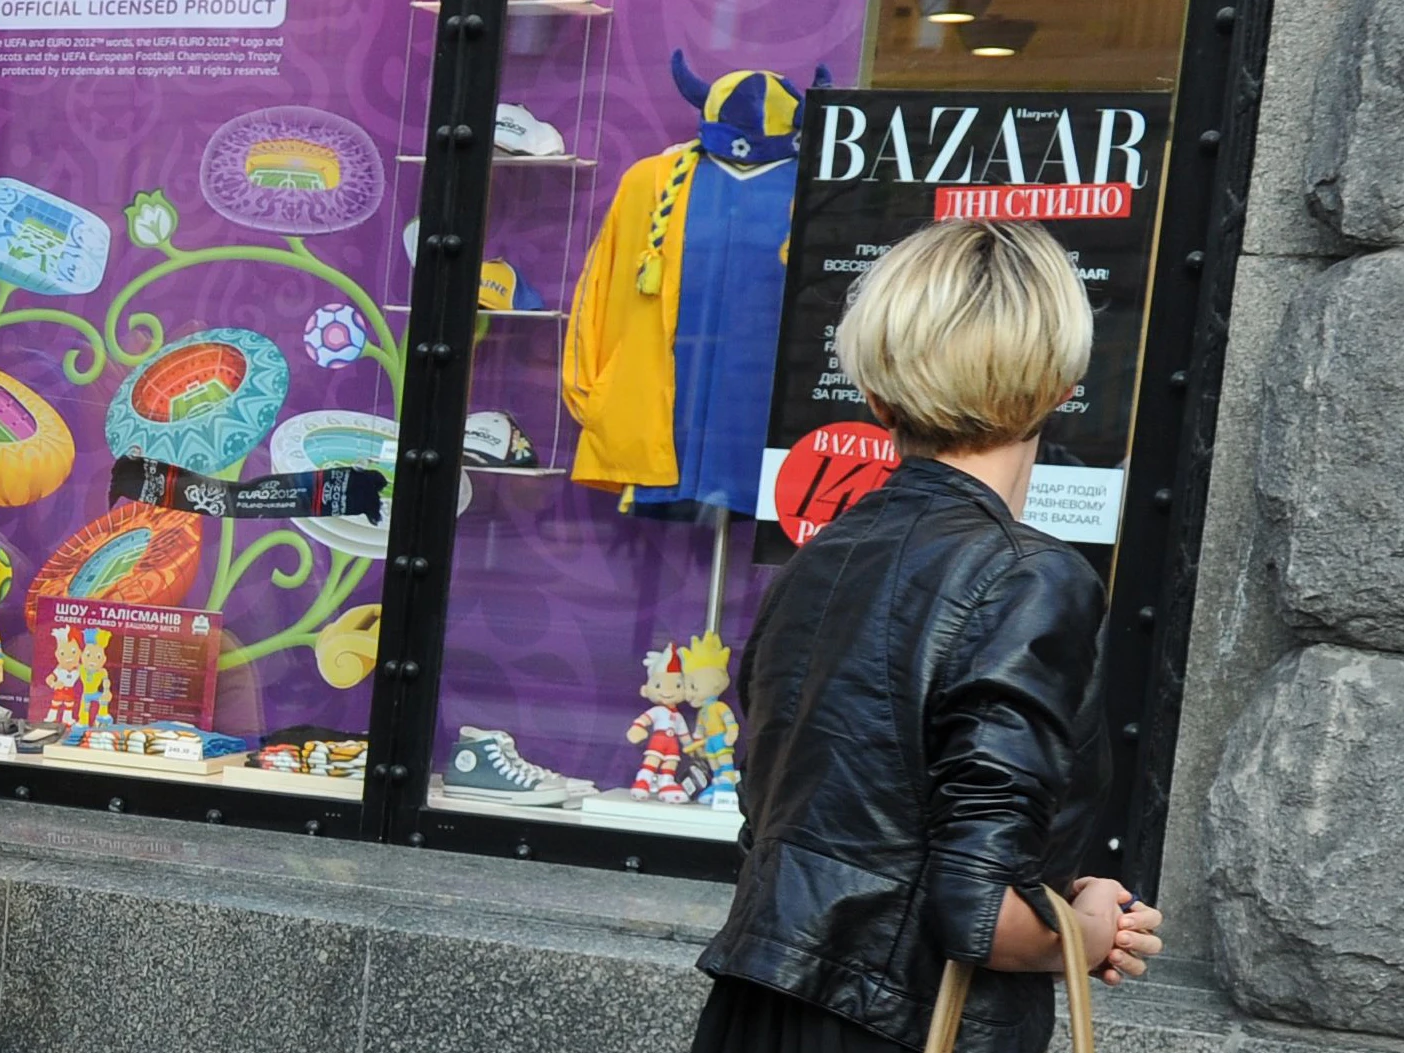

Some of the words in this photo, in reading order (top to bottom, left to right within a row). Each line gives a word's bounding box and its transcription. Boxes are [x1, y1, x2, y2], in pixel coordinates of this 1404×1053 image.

[1, 0, 83, 17] OFFICIAL
[88, 0, 178, 16] LICENSED
[184, 0, 276, 15] PRODUCT
[4, 38, 28, 48] UEFA
[28, 38, 46, 48] and
[46, 38, 72, 48] EURO
[136, 37, 152, 47] the
[153, 37, 177, 47] UEFA
[179, 37, 205, 47] EURO
[241, 38, 264, 49] Logo
[265, 37, 284, 47] and
[24, 52, 43, 62] and
[43, 52, 60, 62] the
[61, 52, 87, 62] UEFA
[88, 52, 134, 64] European
[135, 51, 175, 61] Football
[177, 51, 245, 63] Championship
[248, 51, 283, 63] Trophy
[1, 66, 47, 77] protected
[47, 66, 60, 78] by
[61, 66, 115, 76] trademarks
[117, 66, 136, 76] and
[186, 66, 201, 76] All
[203, 66, 232, 77] rights
[233, 66, 280, 76] reserved.
[1015, 107, 1060, 122] Harper's
[813, 104, 1149, 190] BAZAAR
[941, 189, 1001, 220] ДНІ
[1004, 186, 1123, 218] СТИЛЮ
[54, 615, 82, 625] СЛАВЕК
[87, 618, 117, 628] СЛАВКО
[55, 603, 89, 616] ШОУ
[99, 606, 182, 626] ТАЛІСМАНІВ
